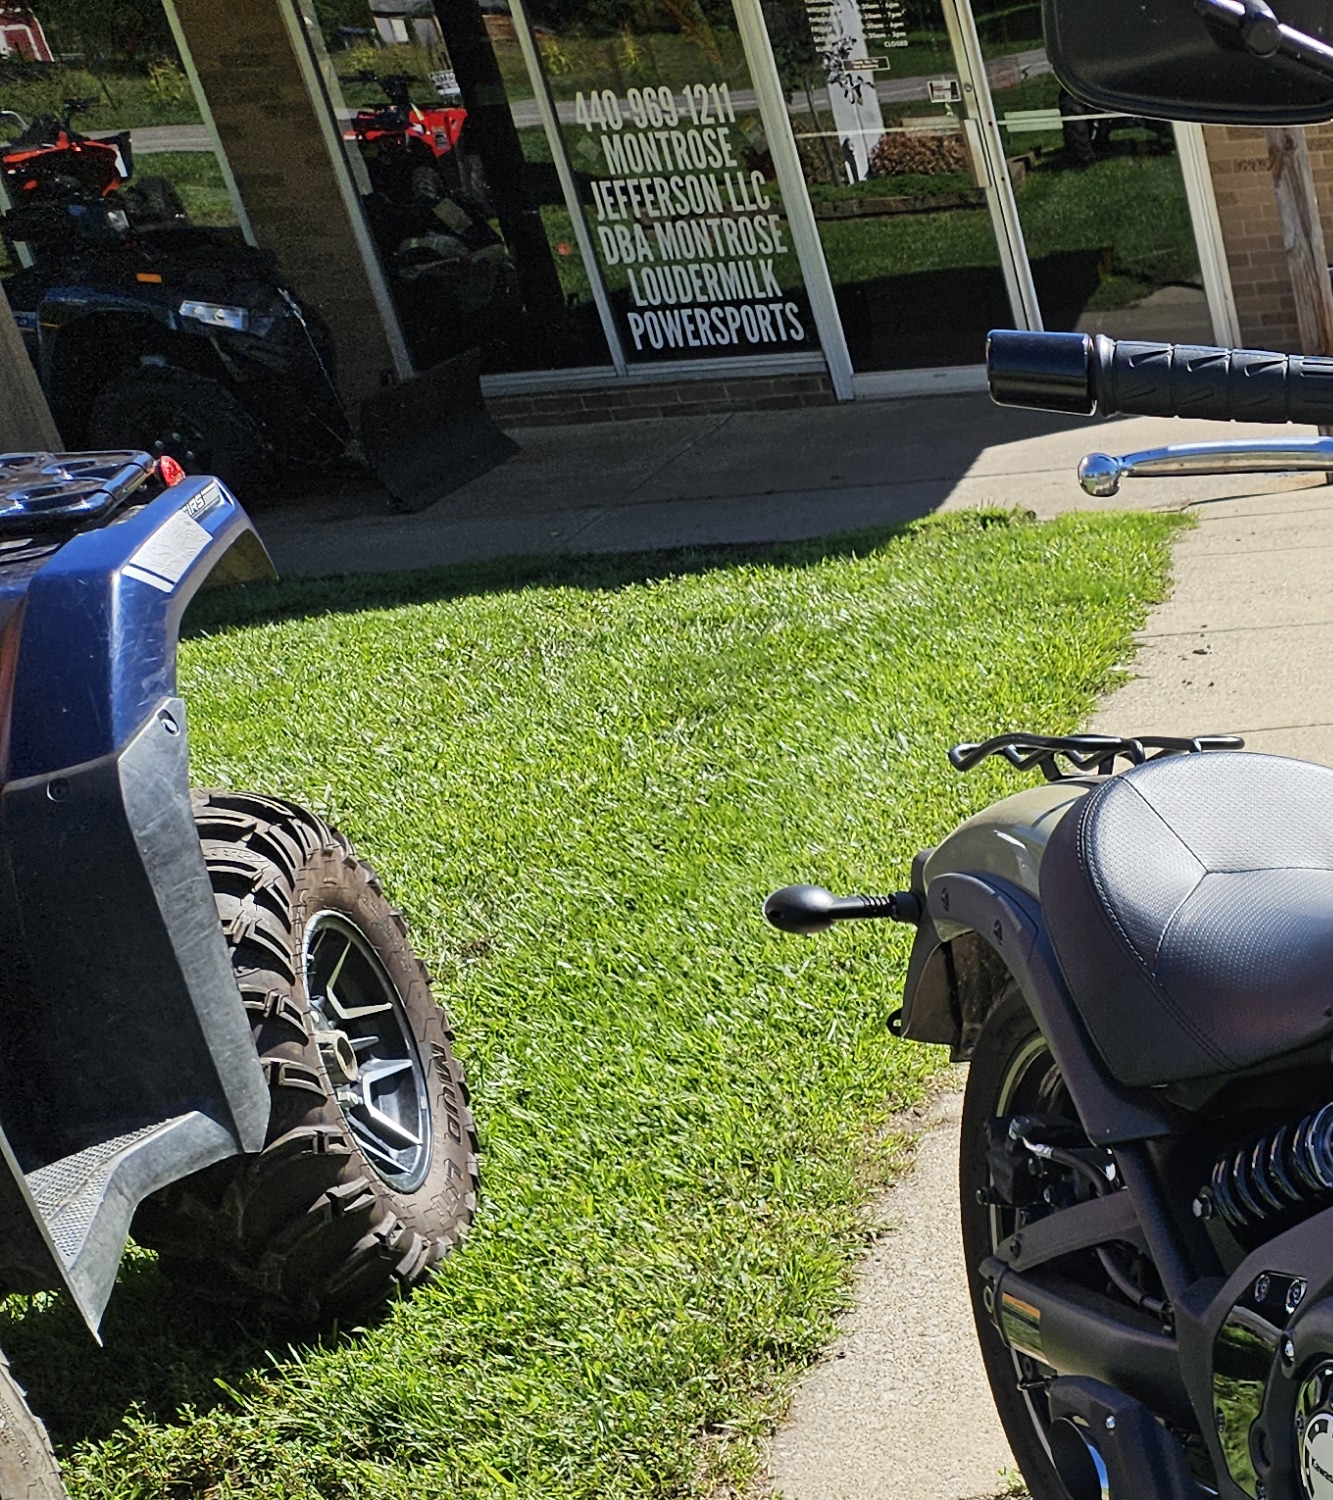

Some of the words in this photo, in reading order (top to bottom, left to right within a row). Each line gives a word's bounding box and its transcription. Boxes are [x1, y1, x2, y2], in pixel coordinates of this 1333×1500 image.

[600, 127, 738, 175] MONTROSE
[590, 173, 724, 221] JEFFERSON
[723, 170, 771, 212] LLC
[597, 223, 655, 265] DBA
[653, 214, 788, 261] MONTROSE
[627, 258, 783, 307] LOUDERMILK
[626, 302, 805, 350] POWERSPORTS
[429, 1039, 464, 1146] MUD
